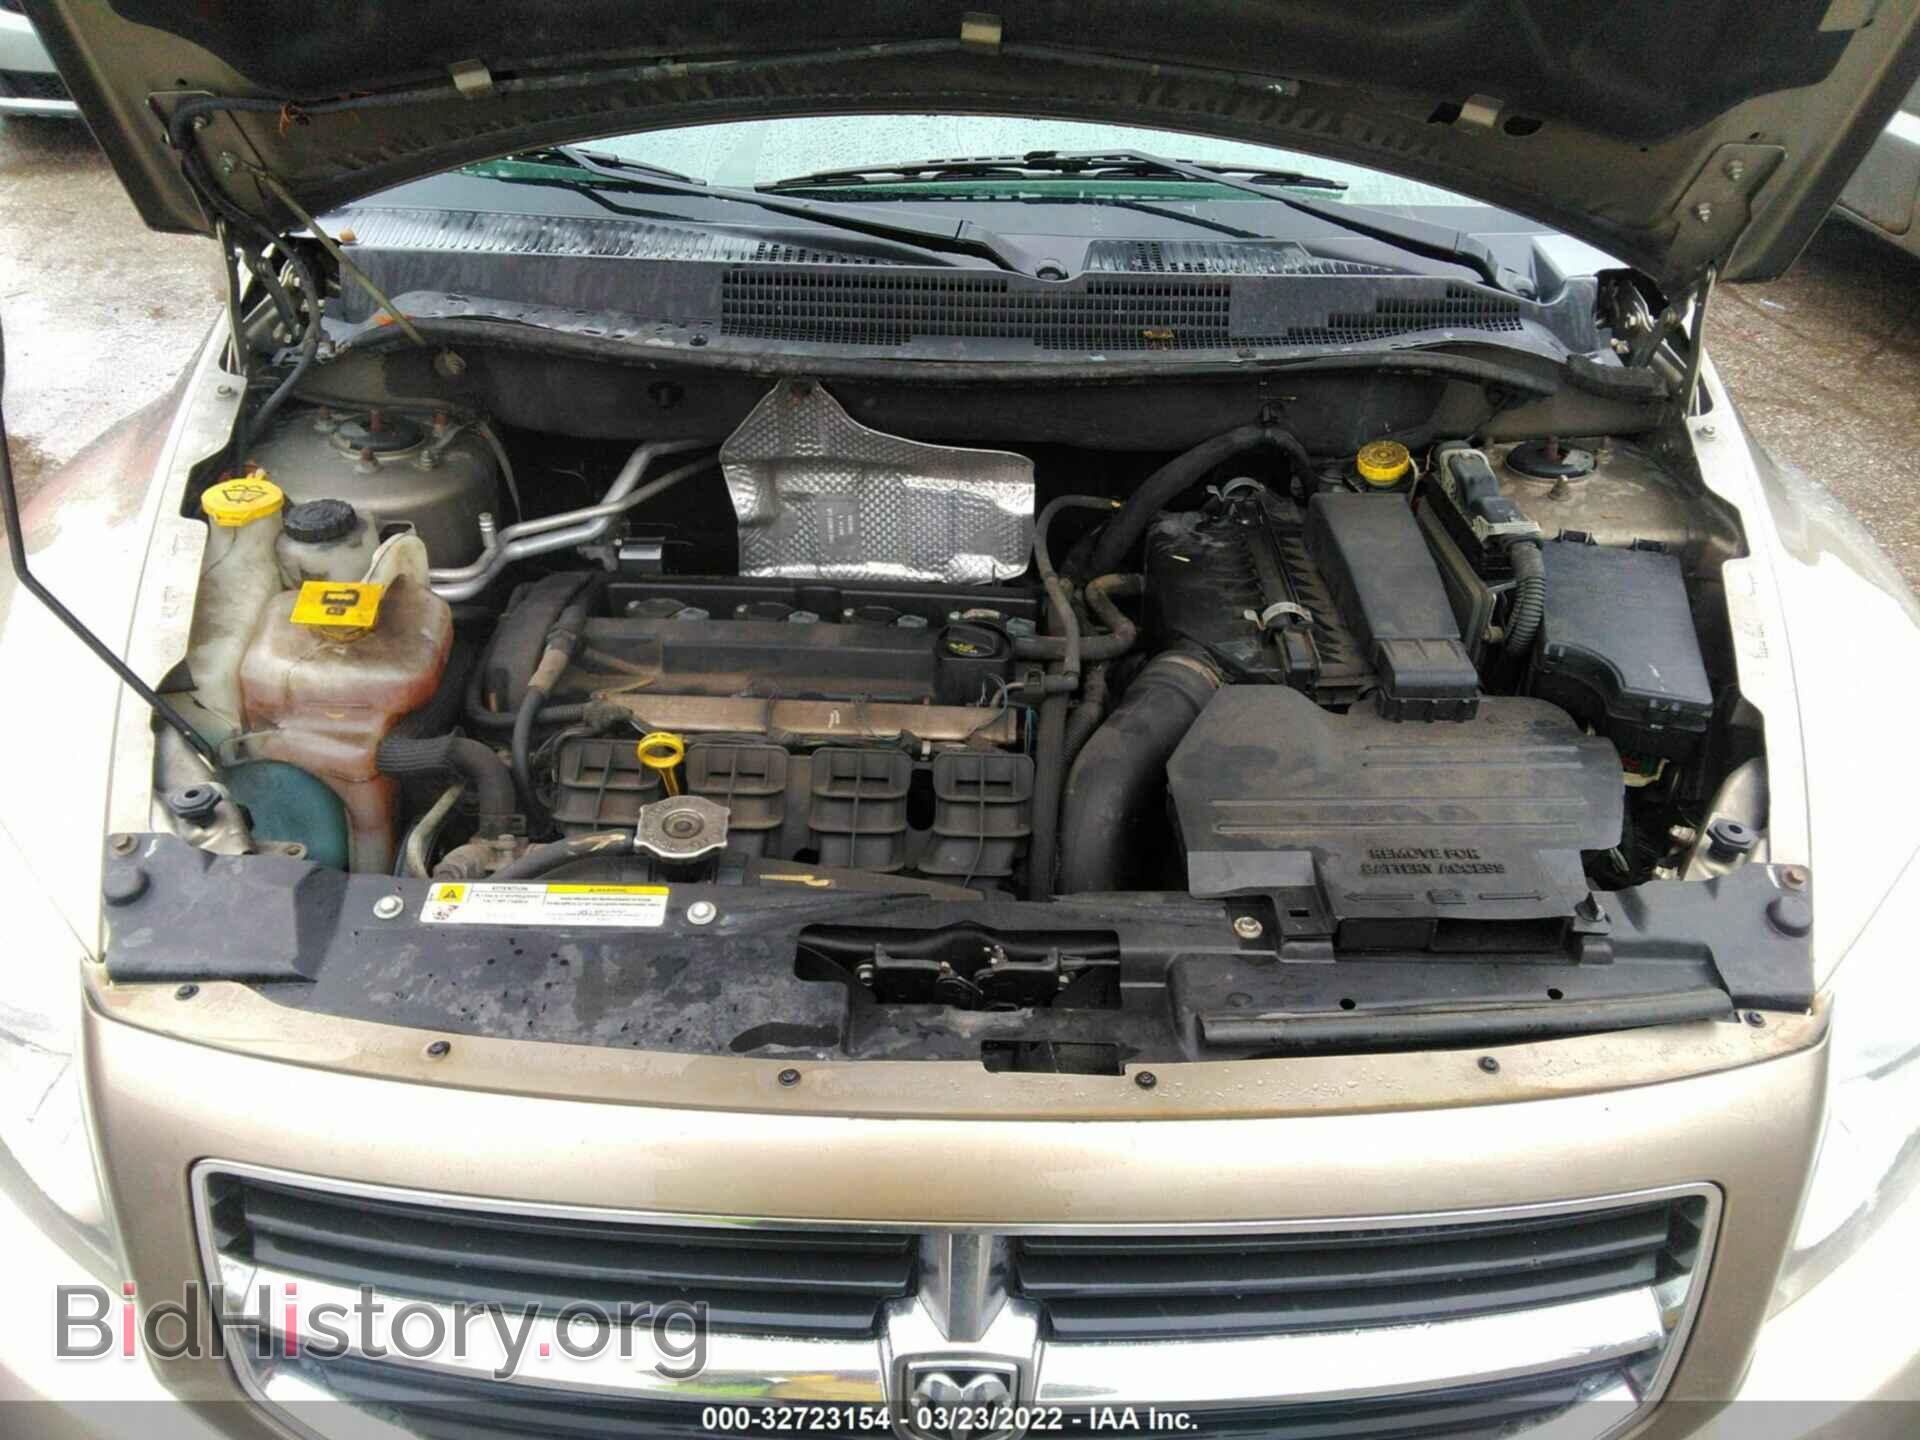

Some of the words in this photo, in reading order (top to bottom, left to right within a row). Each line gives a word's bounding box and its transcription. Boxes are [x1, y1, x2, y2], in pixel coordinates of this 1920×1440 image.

[1368, 848, 1442, 859] REMOVE
[1443, 848, 1481, 859] FOR
[1360, 863, 1433, 875] BATTERY
[1438, 863, 1505, 875] ACCESS
